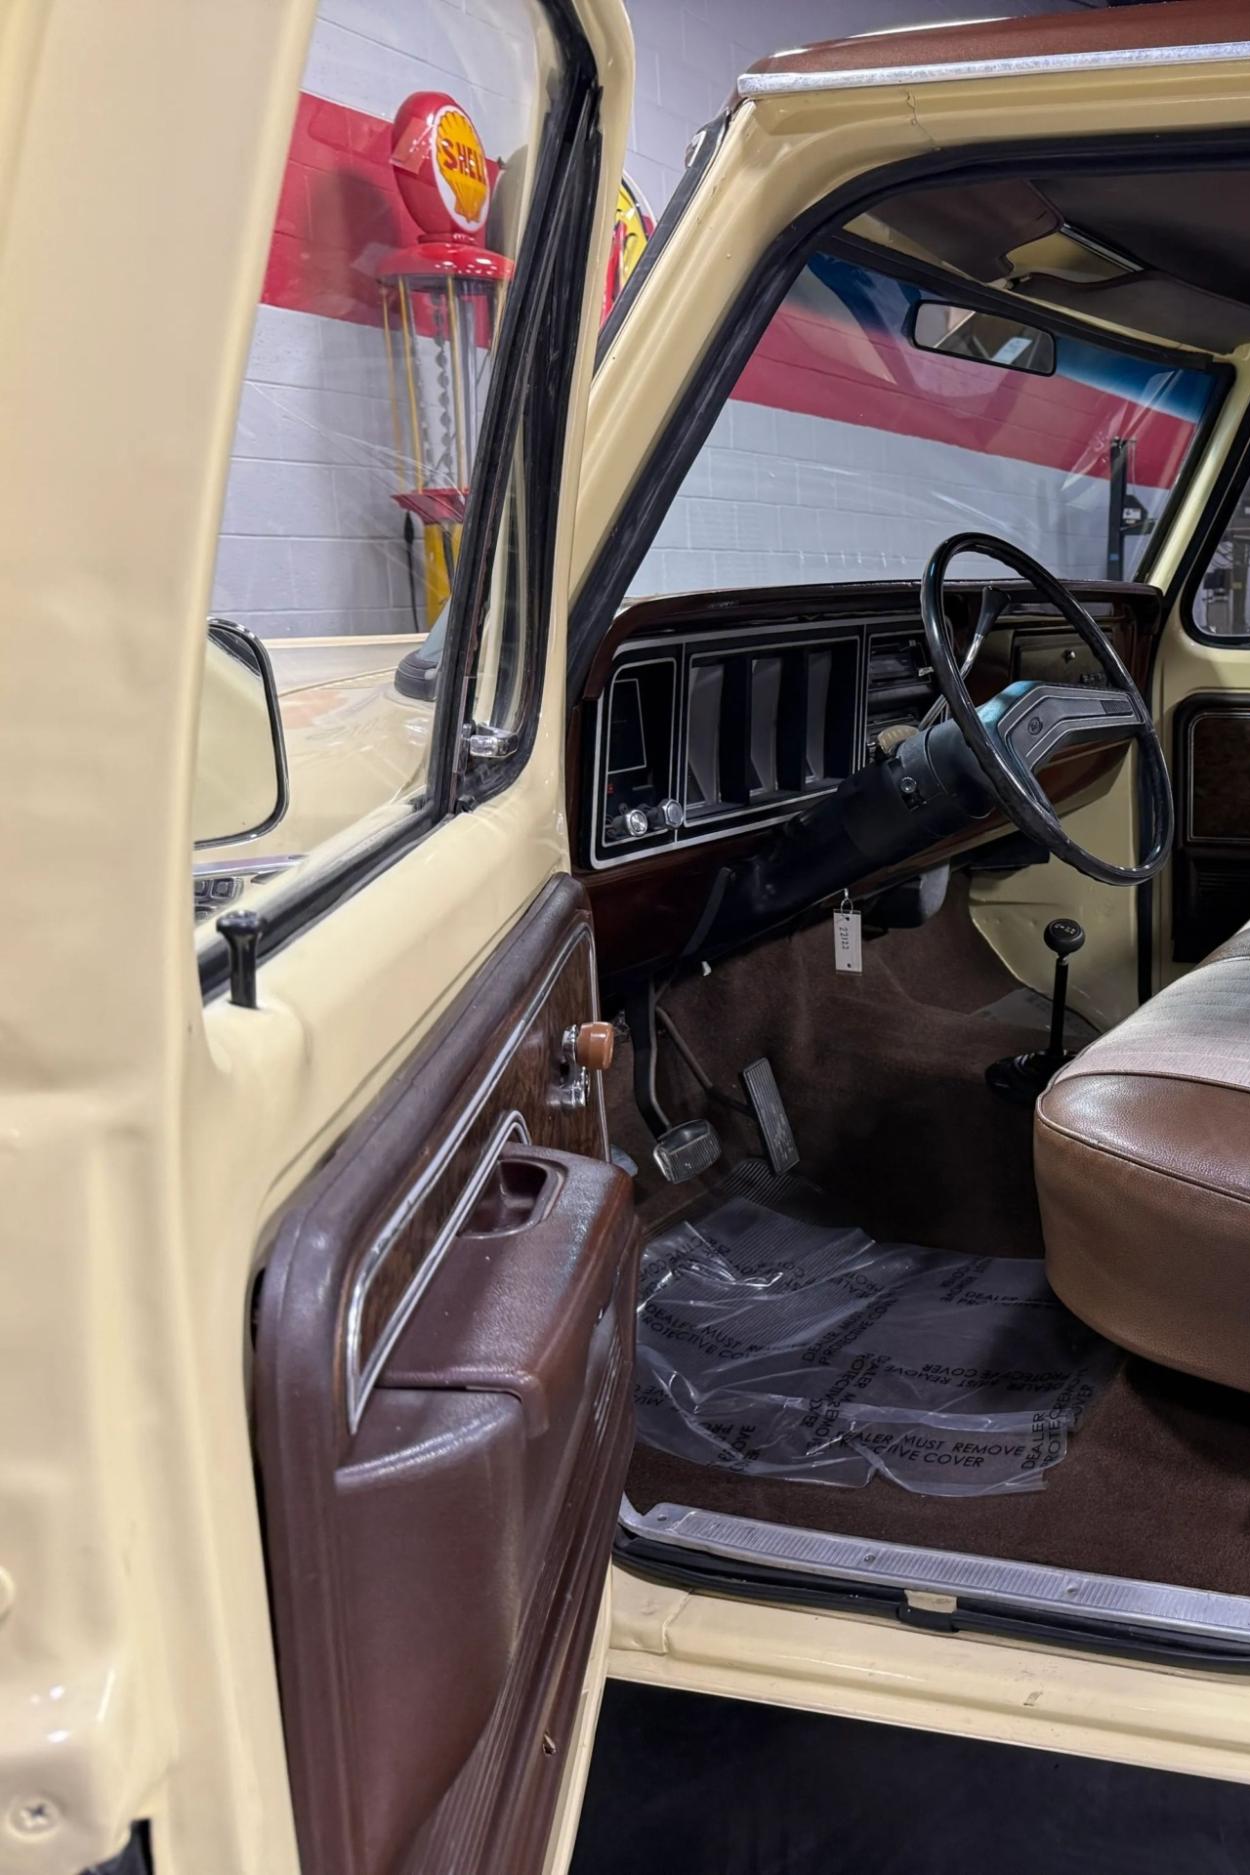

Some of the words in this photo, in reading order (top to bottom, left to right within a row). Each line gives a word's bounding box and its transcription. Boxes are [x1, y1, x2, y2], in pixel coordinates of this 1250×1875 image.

[641, 1314, 718, 1356] ROTECTIVE
[700, 1325, 743, 1350] MUST
[883, 1364, 952, 1386] REMOVE
[922, 1362, 979, 1379] COVER
[903, 1433, 946, 1451] MUST
[951, 1442, 1027, 1457] REMOVE
[1020, 1412, 1046, 1470] DEALER
[922, 1452, 985, 1468] COVER
